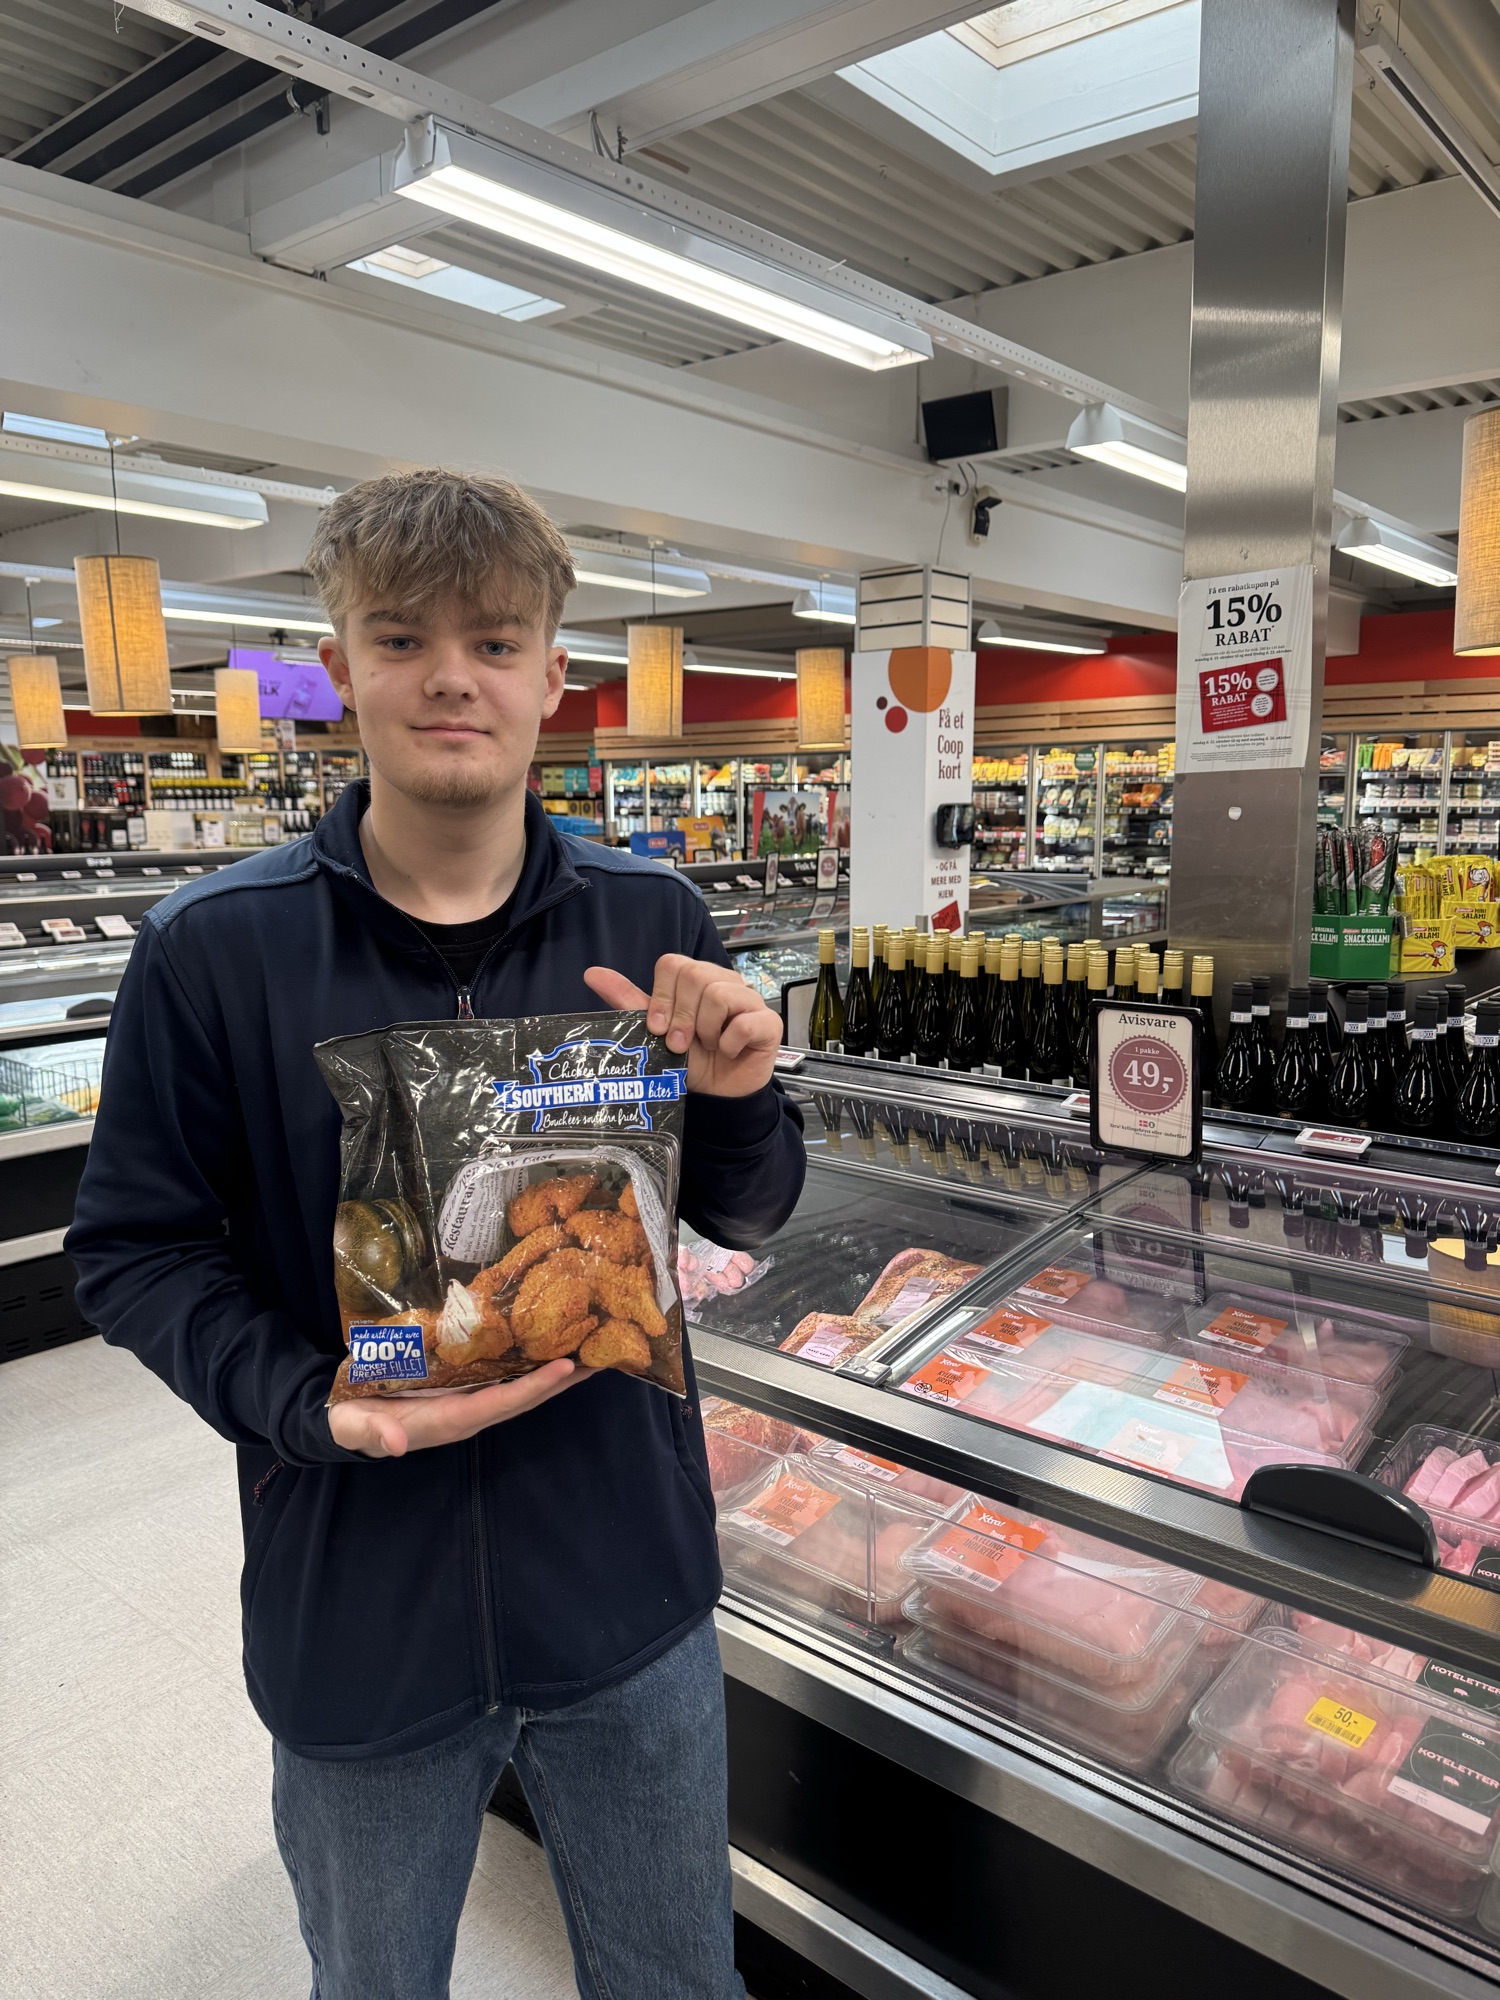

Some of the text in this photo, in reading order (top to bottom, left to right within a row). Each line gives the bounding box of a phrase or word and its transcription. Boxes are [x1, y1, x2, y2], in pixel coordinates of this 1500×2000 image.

[1208, 586, 1217, 595] Få
[1228, 581, 1269, 592] rabatkupon
[1270, 578, 1280, 589] på
[1206, 592, 1282, 630] 15%
[1204, 671, 1252, 696] 15%
[1211, 692, 1247, 706] RABAT
[939, 707, 964, 729] Få et
[937, 734, 964, 759] Coop
[938, 760, 961, 779] kort
[940, 862, 948, 871] OG
[949, 859, 957, 870] FÅ
[931, 875, 962, 886] MERE MED
[938, 889, 954, 899] HJEM
[1461, 912, 1486, 920] SALAMI
[1321, 934, 1338, 943] SALAMI
[1344, 934, 1390, 944] SNACK SALAMI
[1414, 932, 1440, 940] SALAMI
[1118, 1013, 1177, 1029] Avisvare
[1139, 1047, 1160, 1056] pakke
[549, 1059, 633, 1080] Chicken breast
[1122, 1059, 1174, 1094] 49,-
[513, 1080, 672, 1109] SOUTHERN FRIED bites
[543, 1109, 638, 1128] Bouchées southern fried
[1002, 1311, 1023, 1321] Xtra!
[1231, 1310, 1254, 1319] Xtra!
[354, 1329, 370, 1339] made
[352, 1340, 421, 1362] 100%
[352, 1358, 422, 1373] CHICKEN FILLET
[939, 1358, 961, 1369] Xtra!
[1189, 1362, 1214, 1372] Xtra!
[352, 1368, 387, 1378] BREAST
[978, 1513, 1007, 1527] Xtra!
[963, 1539, 1004, 1562] INDERFILET
[1334, 1707, 1358, 1727] 50,-
[1462, 1732, 1486, 1746] coop
[1418, 1747, 1500, 1788] KOTELETTER
